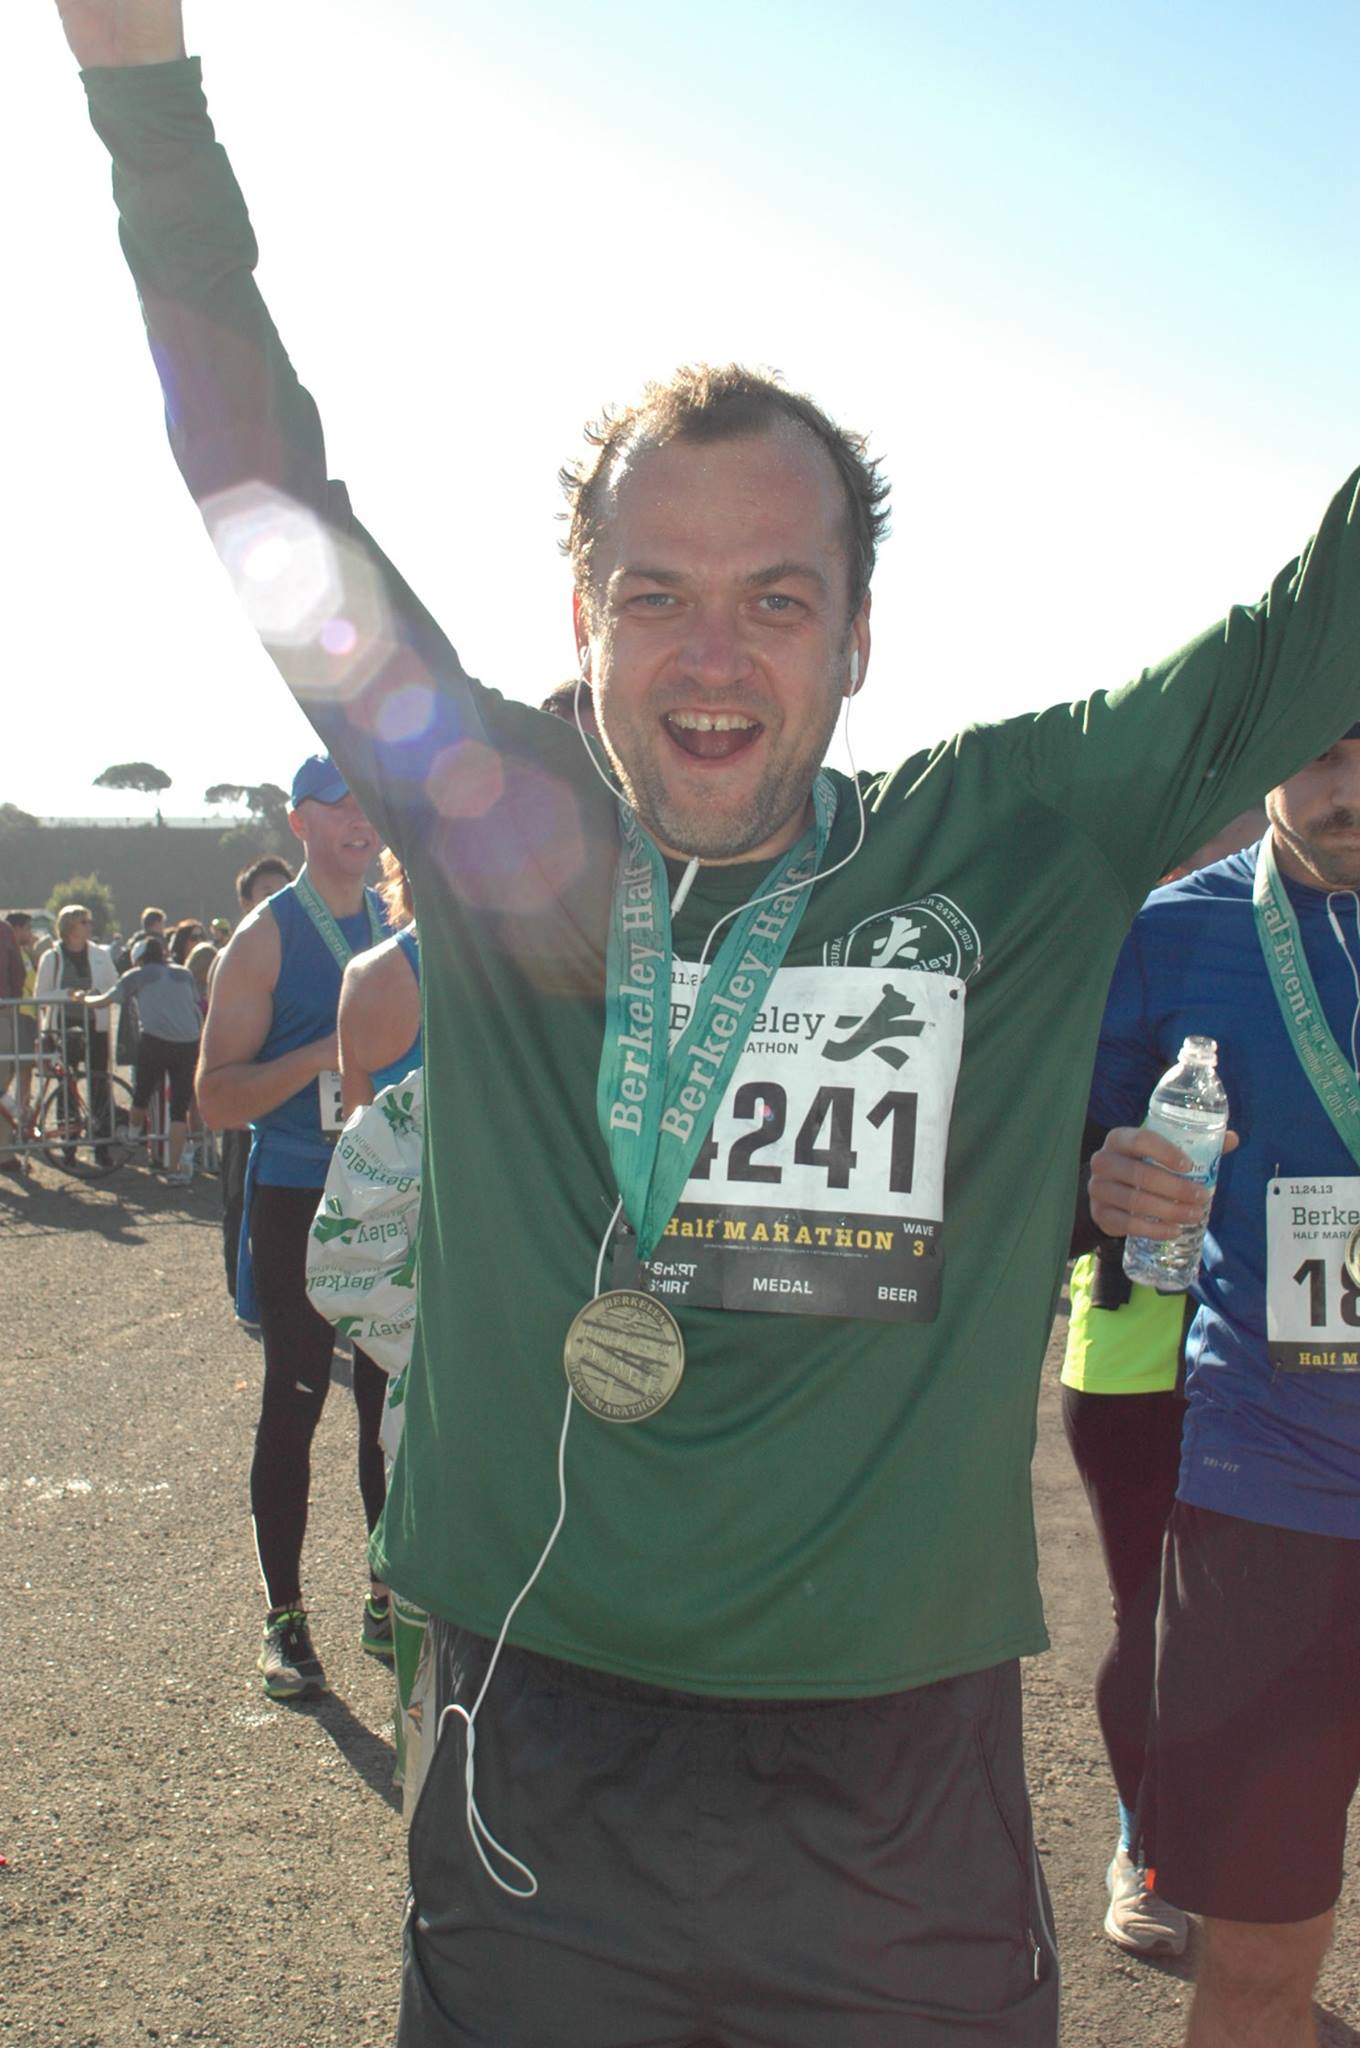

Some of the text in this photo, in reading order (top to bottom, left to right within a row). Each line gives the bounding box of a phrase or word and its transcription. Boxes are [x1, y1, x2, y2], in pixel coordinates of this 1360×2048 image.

[622, 860, 653, 932] Half
[958, 927, 974, 951] 2013
[1274, 936, 1313, 1025] Event
[610, 942, 666, 1137] Berkeley
[660, 950, 775, 1145] Berkeley
[1290, 1184, 1334, 1195] 11.24.13
[1291, 1206, 1360, 1226] Berke
[723, 1220, 895, 1250] MARATHON
[903, 1222, 934, 1237] WAVE
[1293, 1231, 1320, 1240] HALF
[912, 1240, 925, 1257] 3
[753, 1277, 814, 1295] MEDAL
[878, 1285, 918, 1302] BEER
[1299, 1352, 1337, 1366] Half
